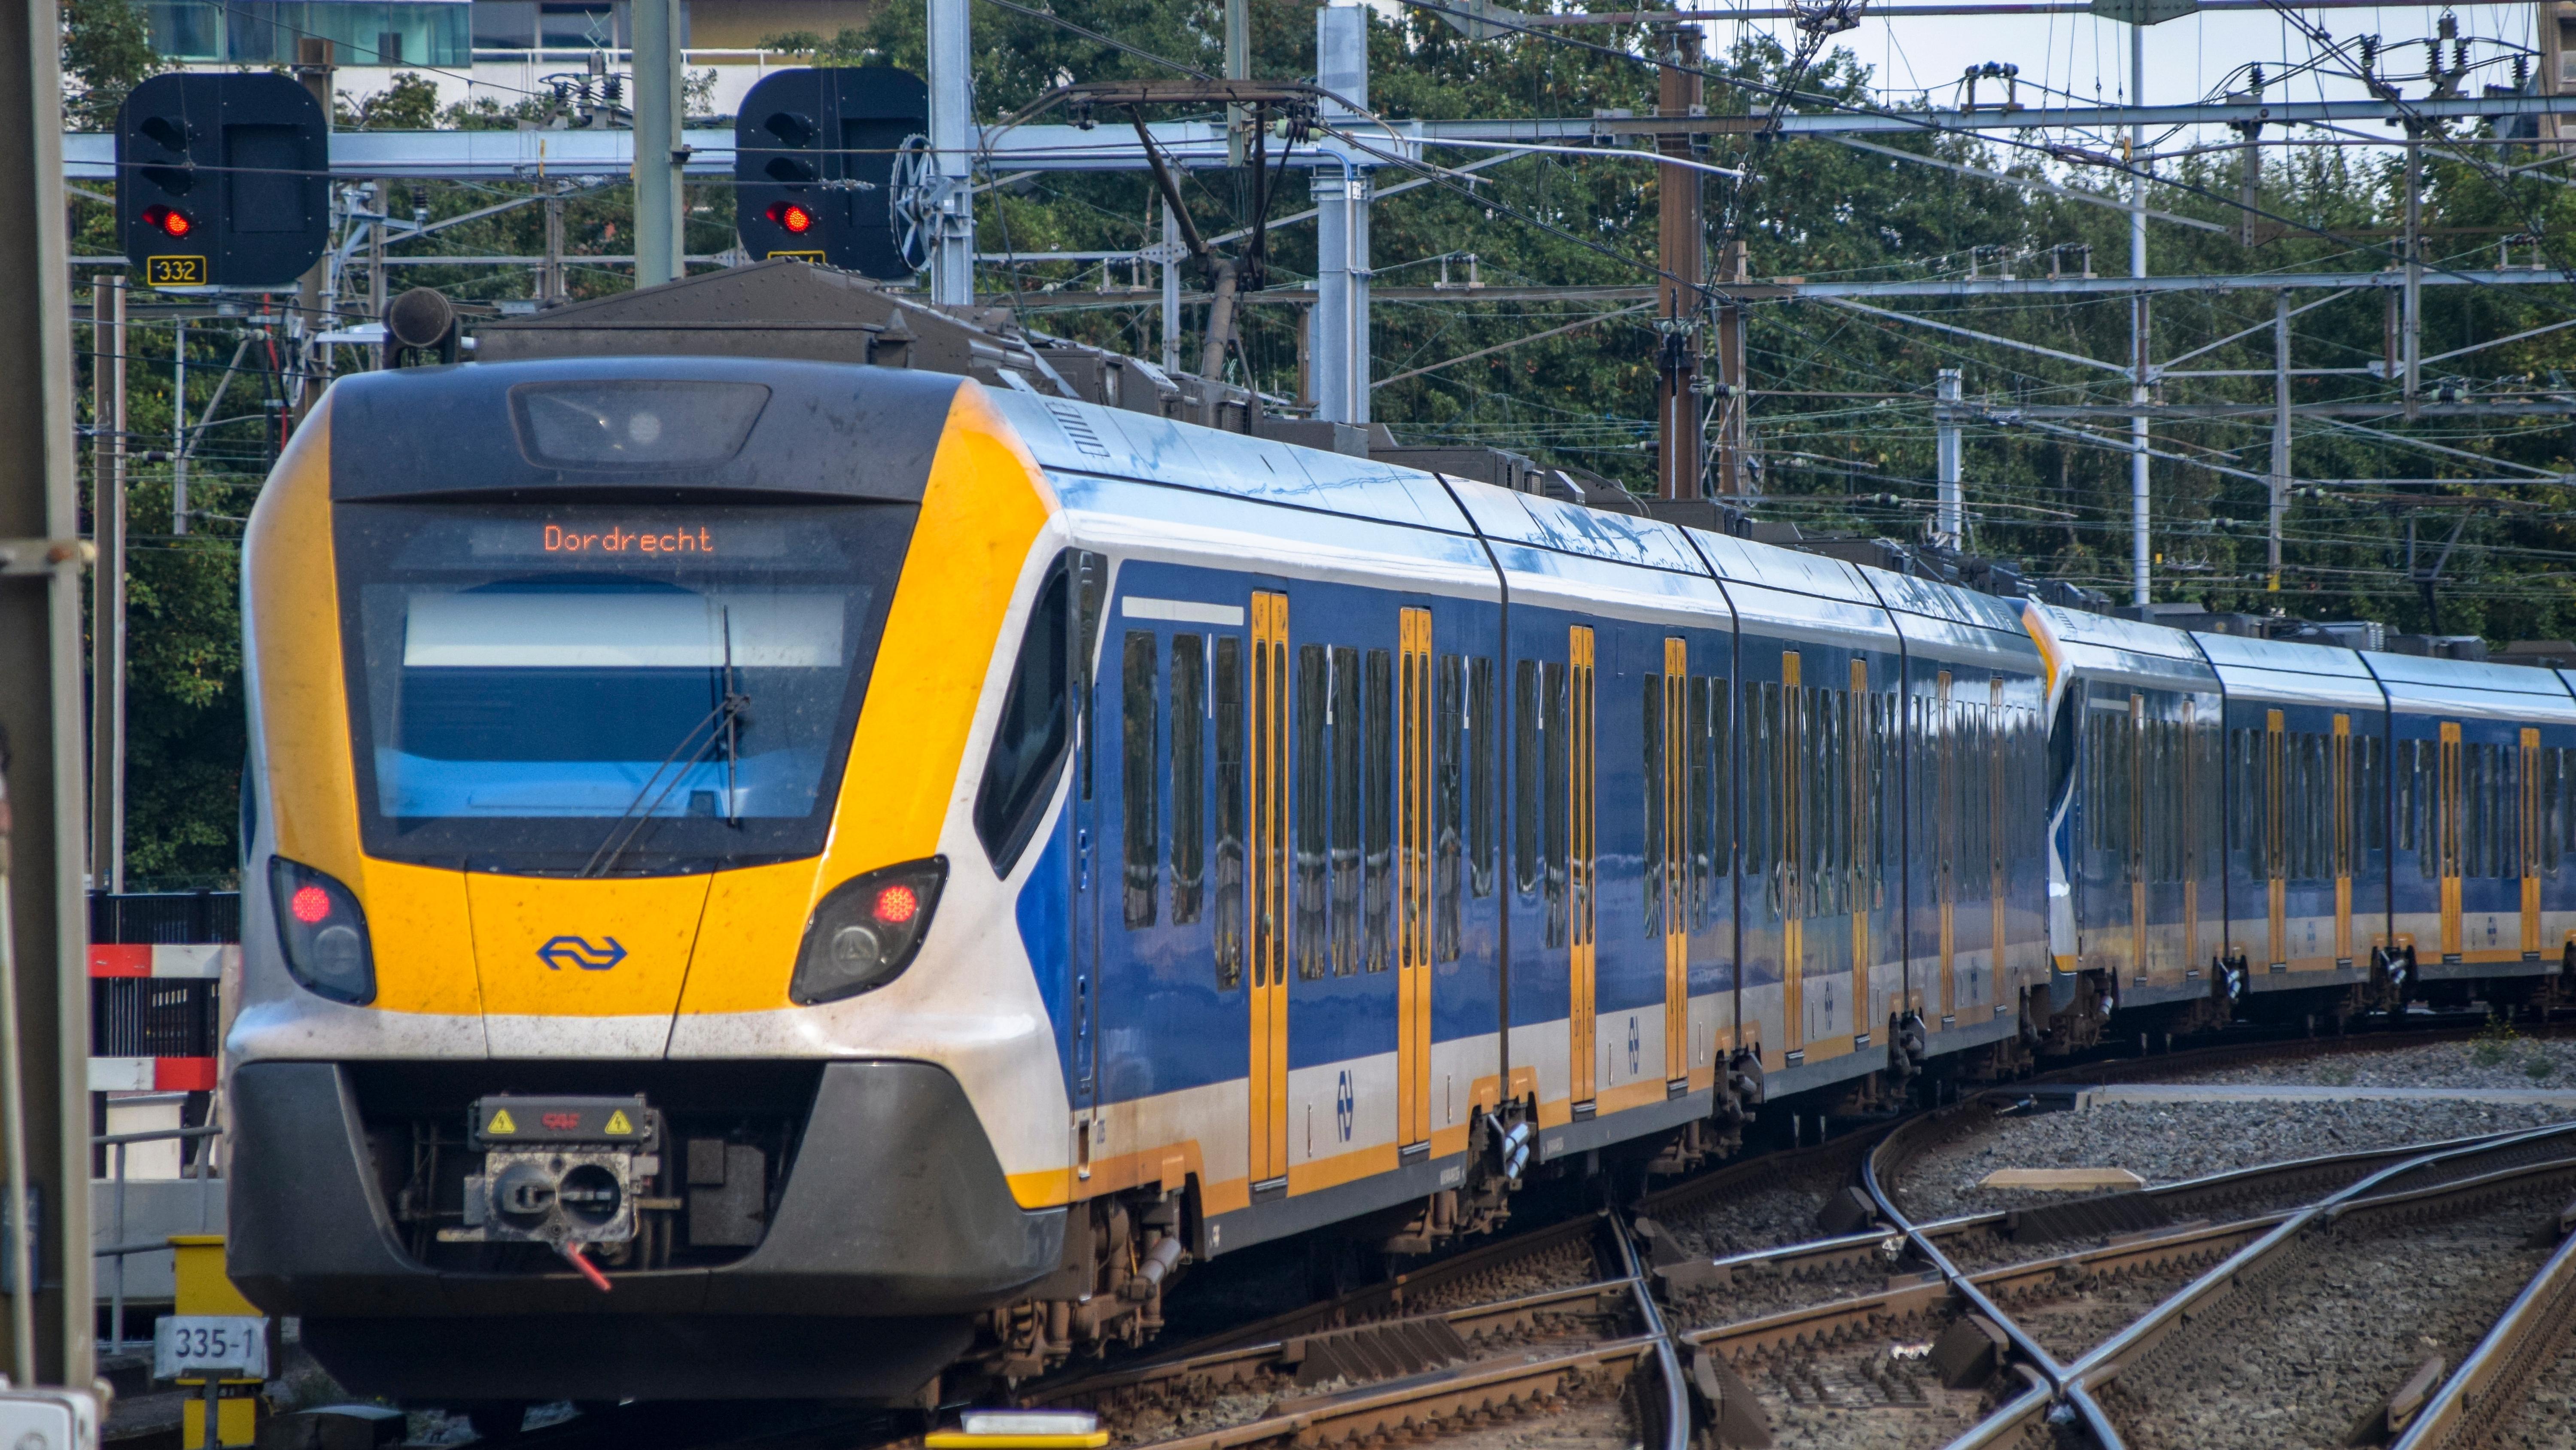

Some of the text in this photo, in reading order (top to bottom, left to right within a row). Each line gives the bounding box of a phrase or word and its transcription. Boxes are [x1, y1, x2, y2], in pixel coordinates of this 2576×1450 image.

[159, 261, 195, 280] 332
[544, 526, 713, 552] Dordrecht
[175, 1328, 253, 1359] 335-1
